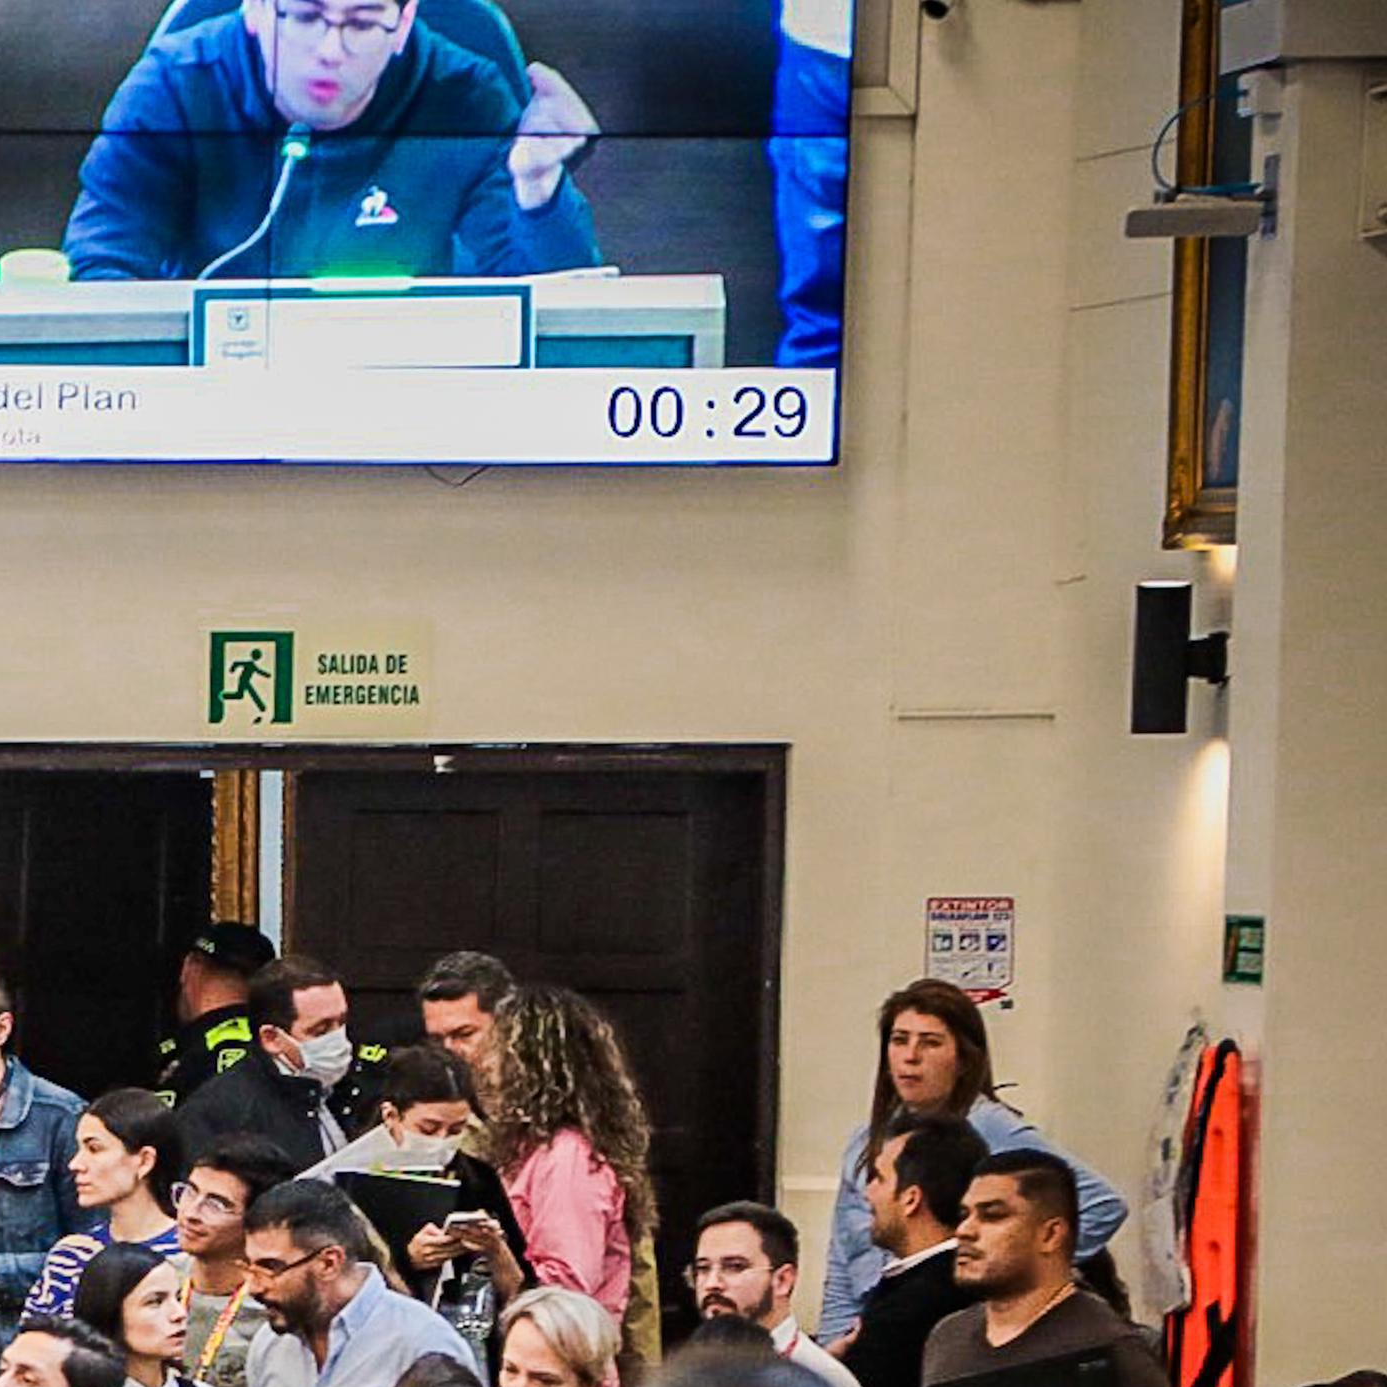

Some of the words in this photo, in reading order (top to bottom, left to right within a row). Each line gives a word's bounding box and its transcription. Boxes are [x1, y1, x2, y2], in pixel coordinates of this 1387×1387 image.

[58, 382, 136, 410] Plan
[317, 653, 379, 675] SALIDA
[386, 654, 408, 674] DE
[305, 684, 420, 706] EMERGENCIA
